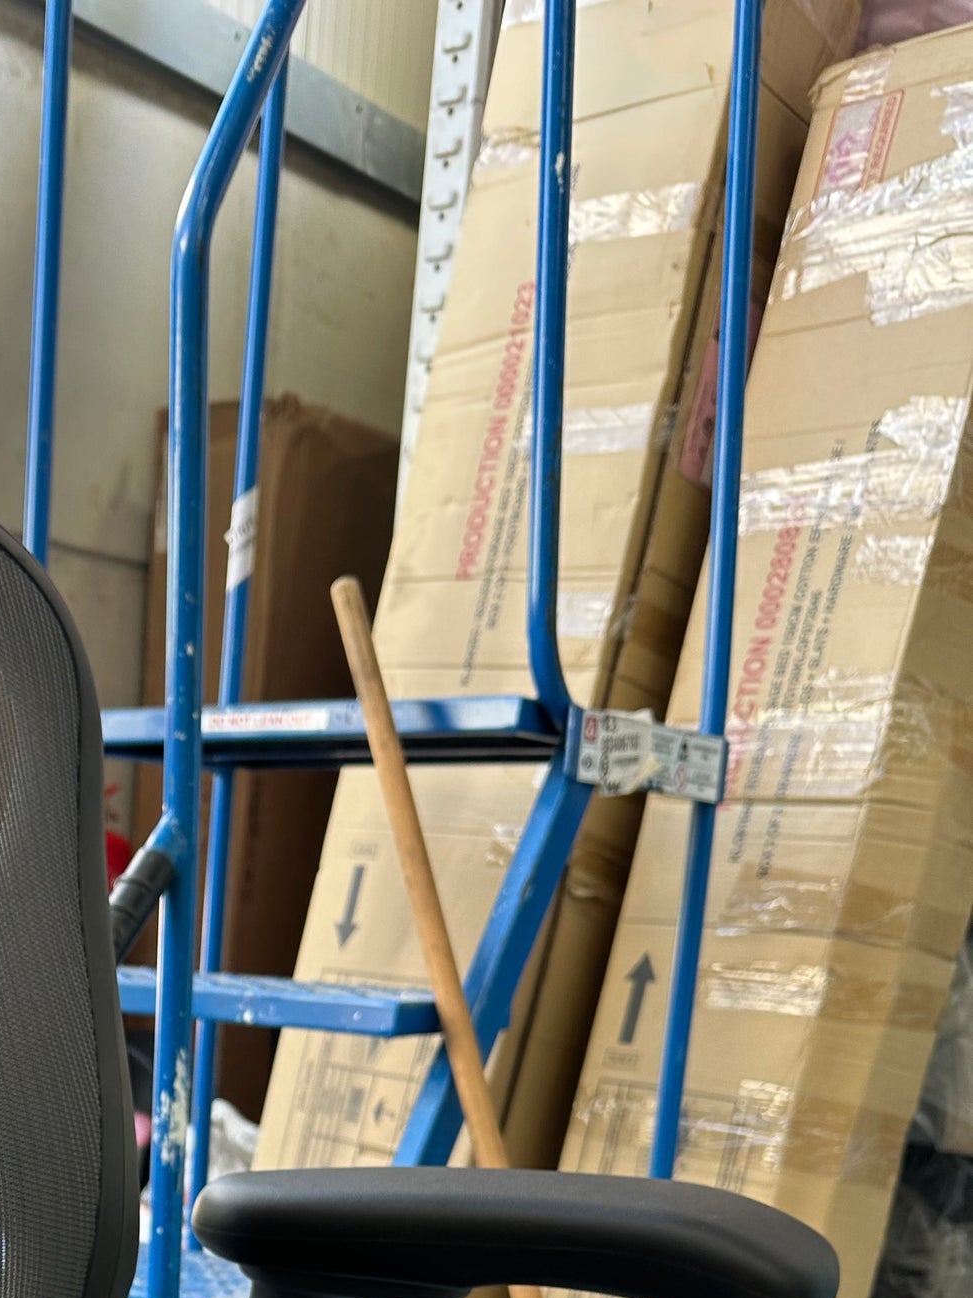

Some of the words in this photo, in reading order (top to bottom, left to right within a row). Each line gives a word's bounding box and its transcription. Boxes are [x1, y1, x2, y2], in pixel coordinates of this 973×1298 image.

[454, 414, 510, 582] PRODUCTION
[719, 633, 773, 809] CTION
[753, 498, 808, 632] 0002808
